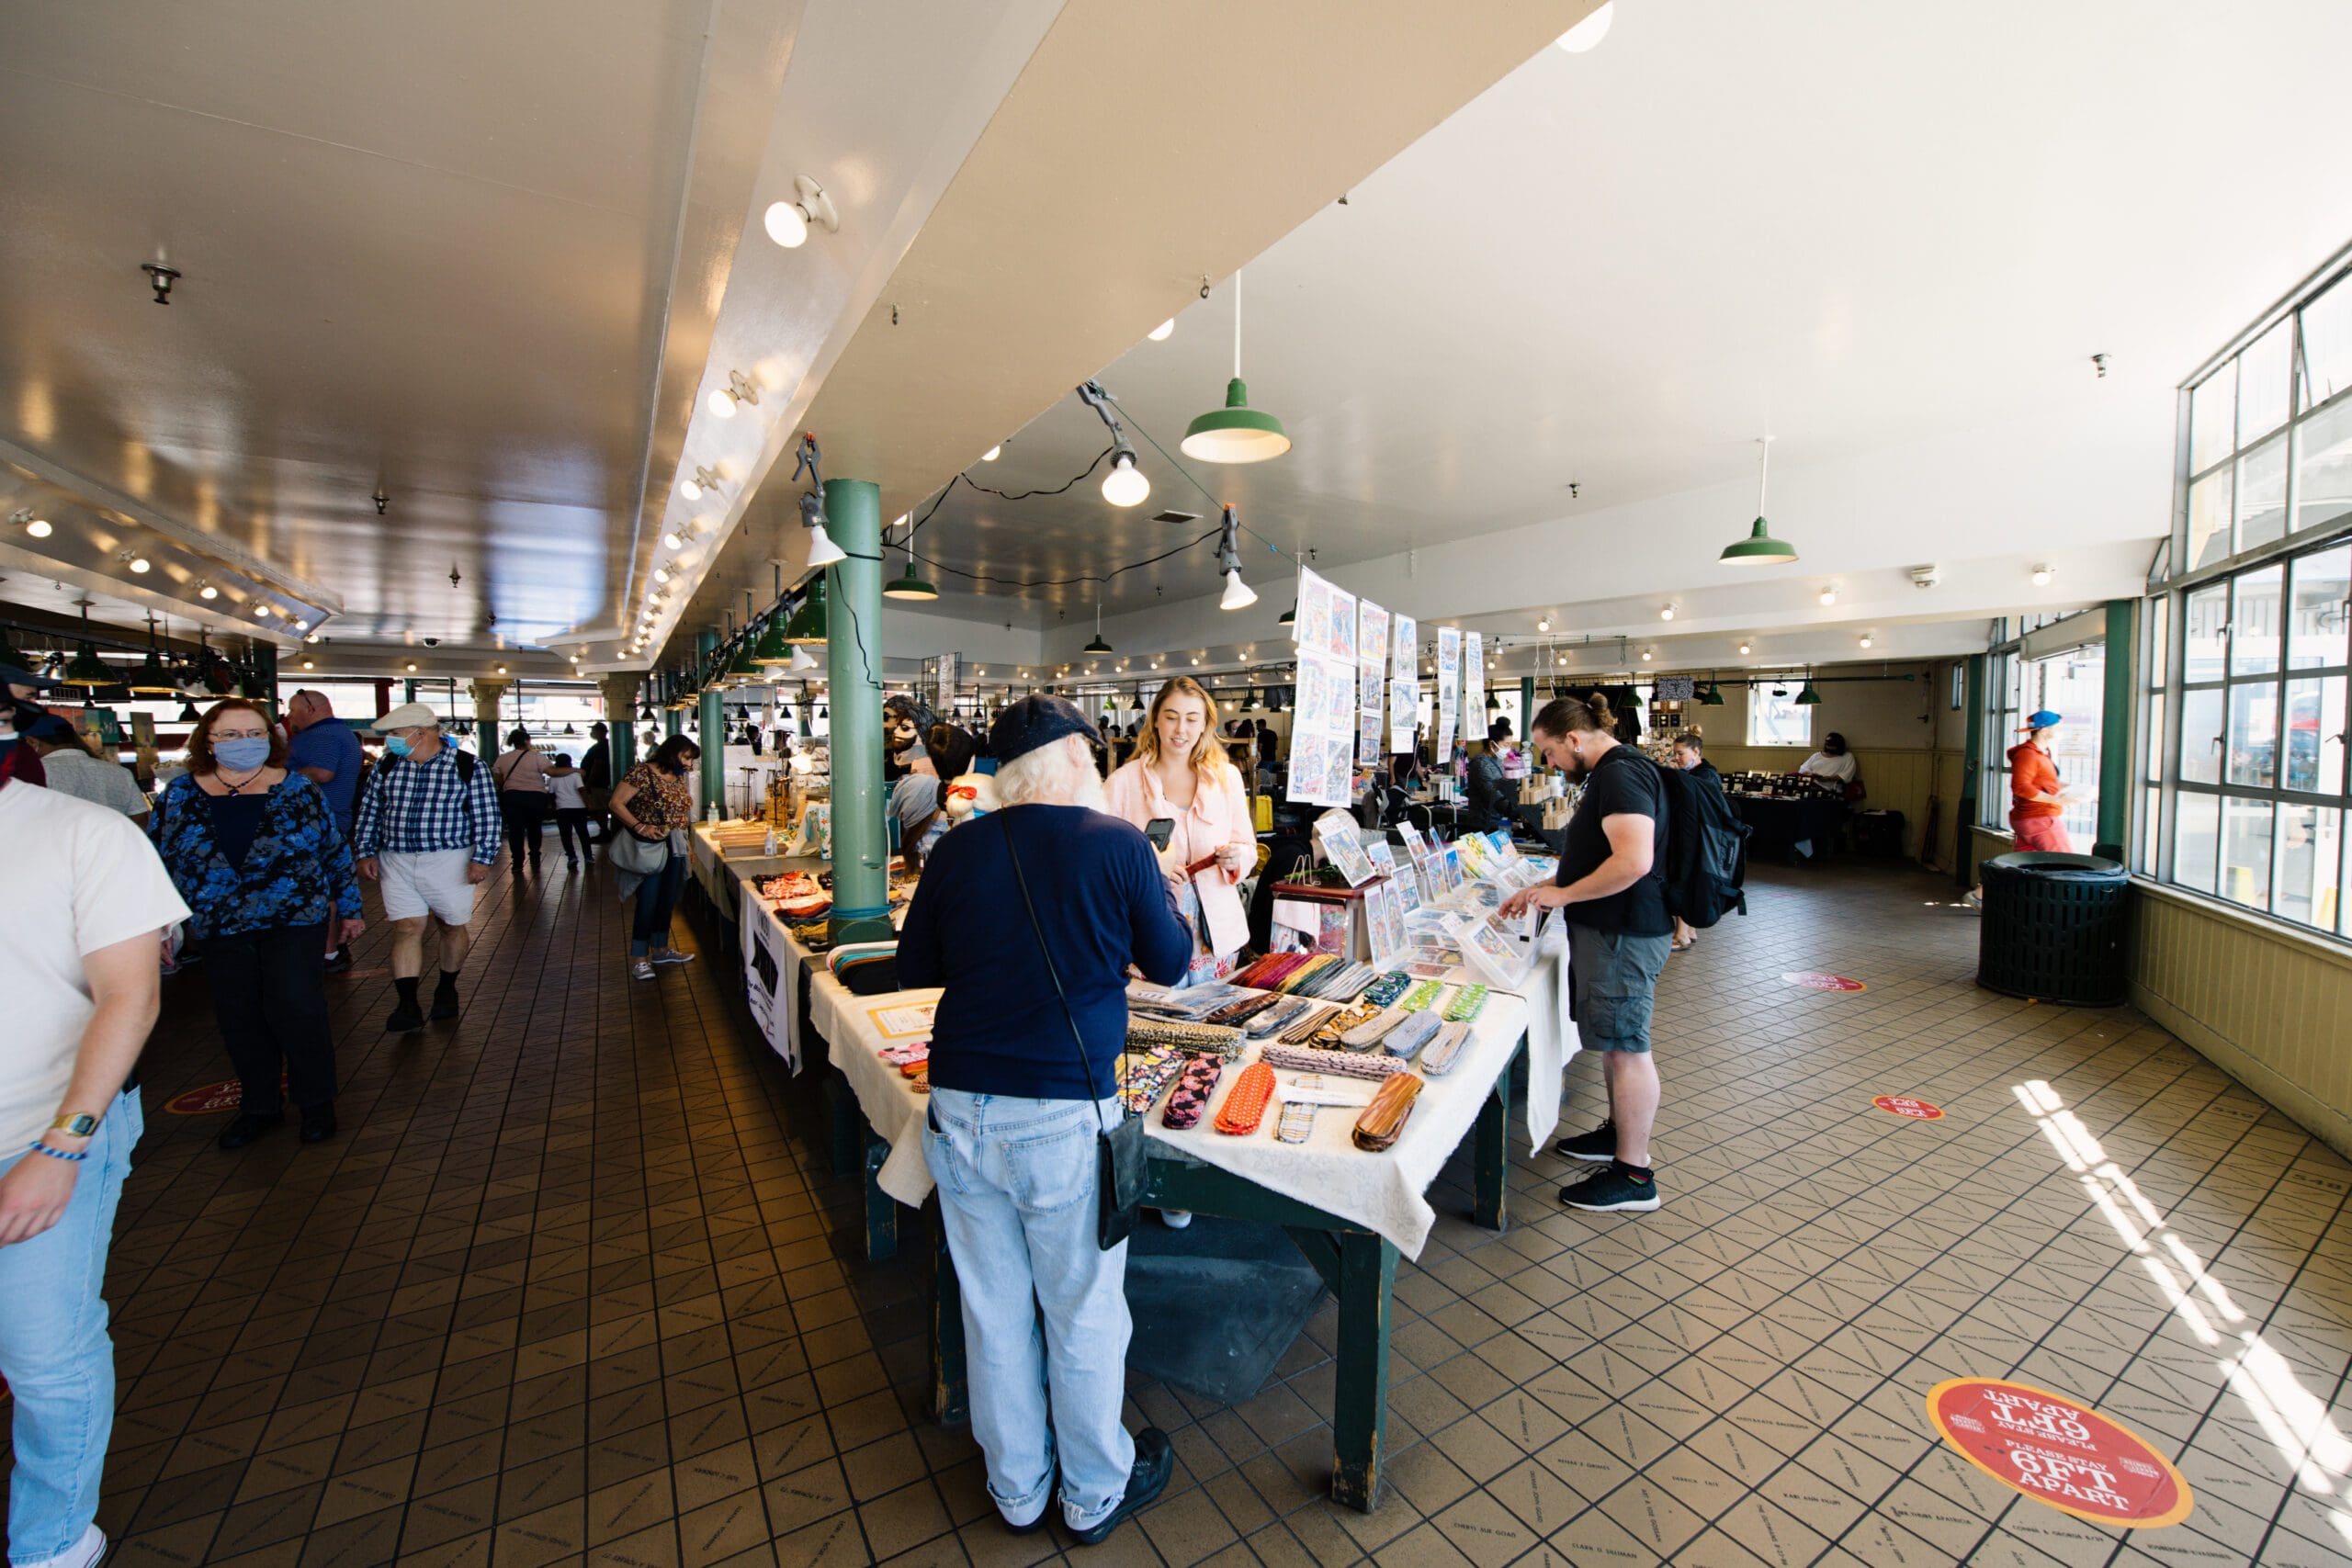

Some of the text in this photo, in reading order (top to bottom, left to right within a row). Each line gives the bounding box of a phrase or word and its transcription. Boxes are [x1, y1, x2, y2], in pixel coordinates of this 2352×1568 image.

[2211, 1106, 2255, 1118] 549
[2292, 1173, 2342, 1190] 548
[1984, 1389, 2080, 1421] APART
[1991, 1401, 2090, 1441] 6FT
[1997, 1421, 2033, 1436] STAY
[2036, 1430, 2097, 1451] PLEASE
[2005, 1439, 2066, 1461] PLEASE
[2067, 1456, 2108, 1471] STAY
[2010, 1450, 2117, 1495] 6FT
[1532, 1491, 1540, 1505] JOHN
[2019, 1472, 2130, 1511] APART
[1534, 1506, 1544, 1523] GOAD
[1453, 1522, 1476, 1531] CHERYL
[1494, 1529, 1516, 1538] GOAD
[1571, 1542, 1593, 1551] CLARK
